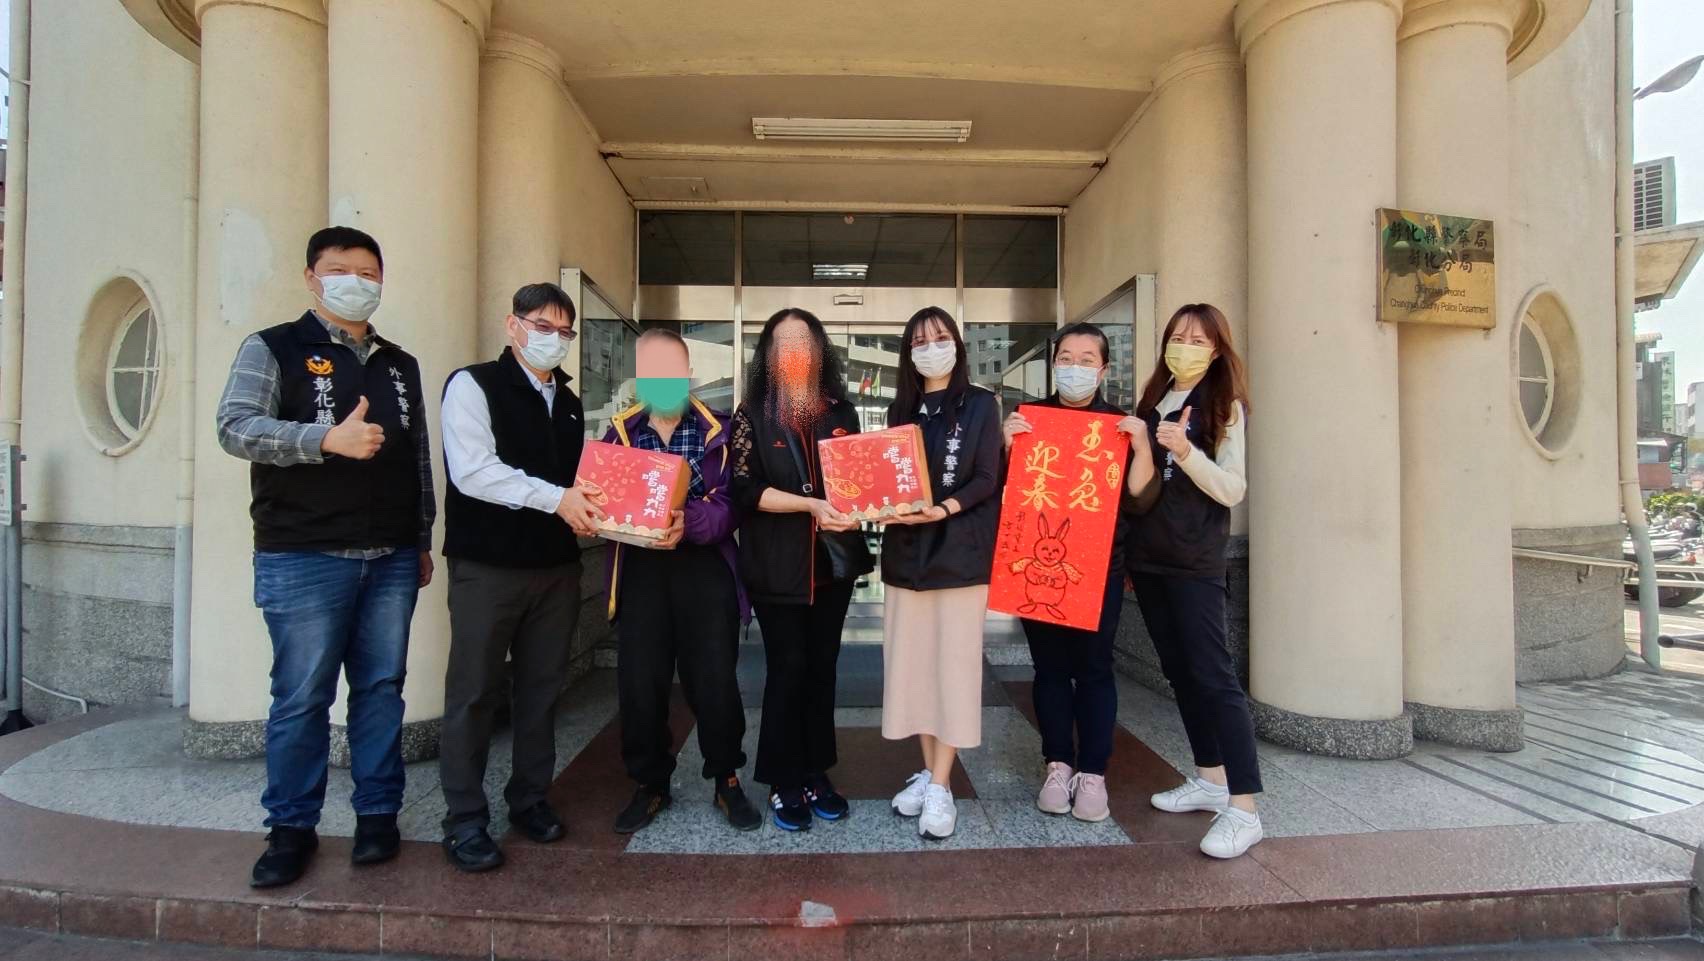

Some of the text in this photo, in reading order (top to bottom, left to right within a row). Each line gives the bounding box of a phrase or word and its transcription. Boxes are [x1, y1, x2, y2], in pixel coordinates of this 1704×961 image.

[313, 376, 336, 424] 彰化縣
[388, 366, 411, 430] 外事警察
